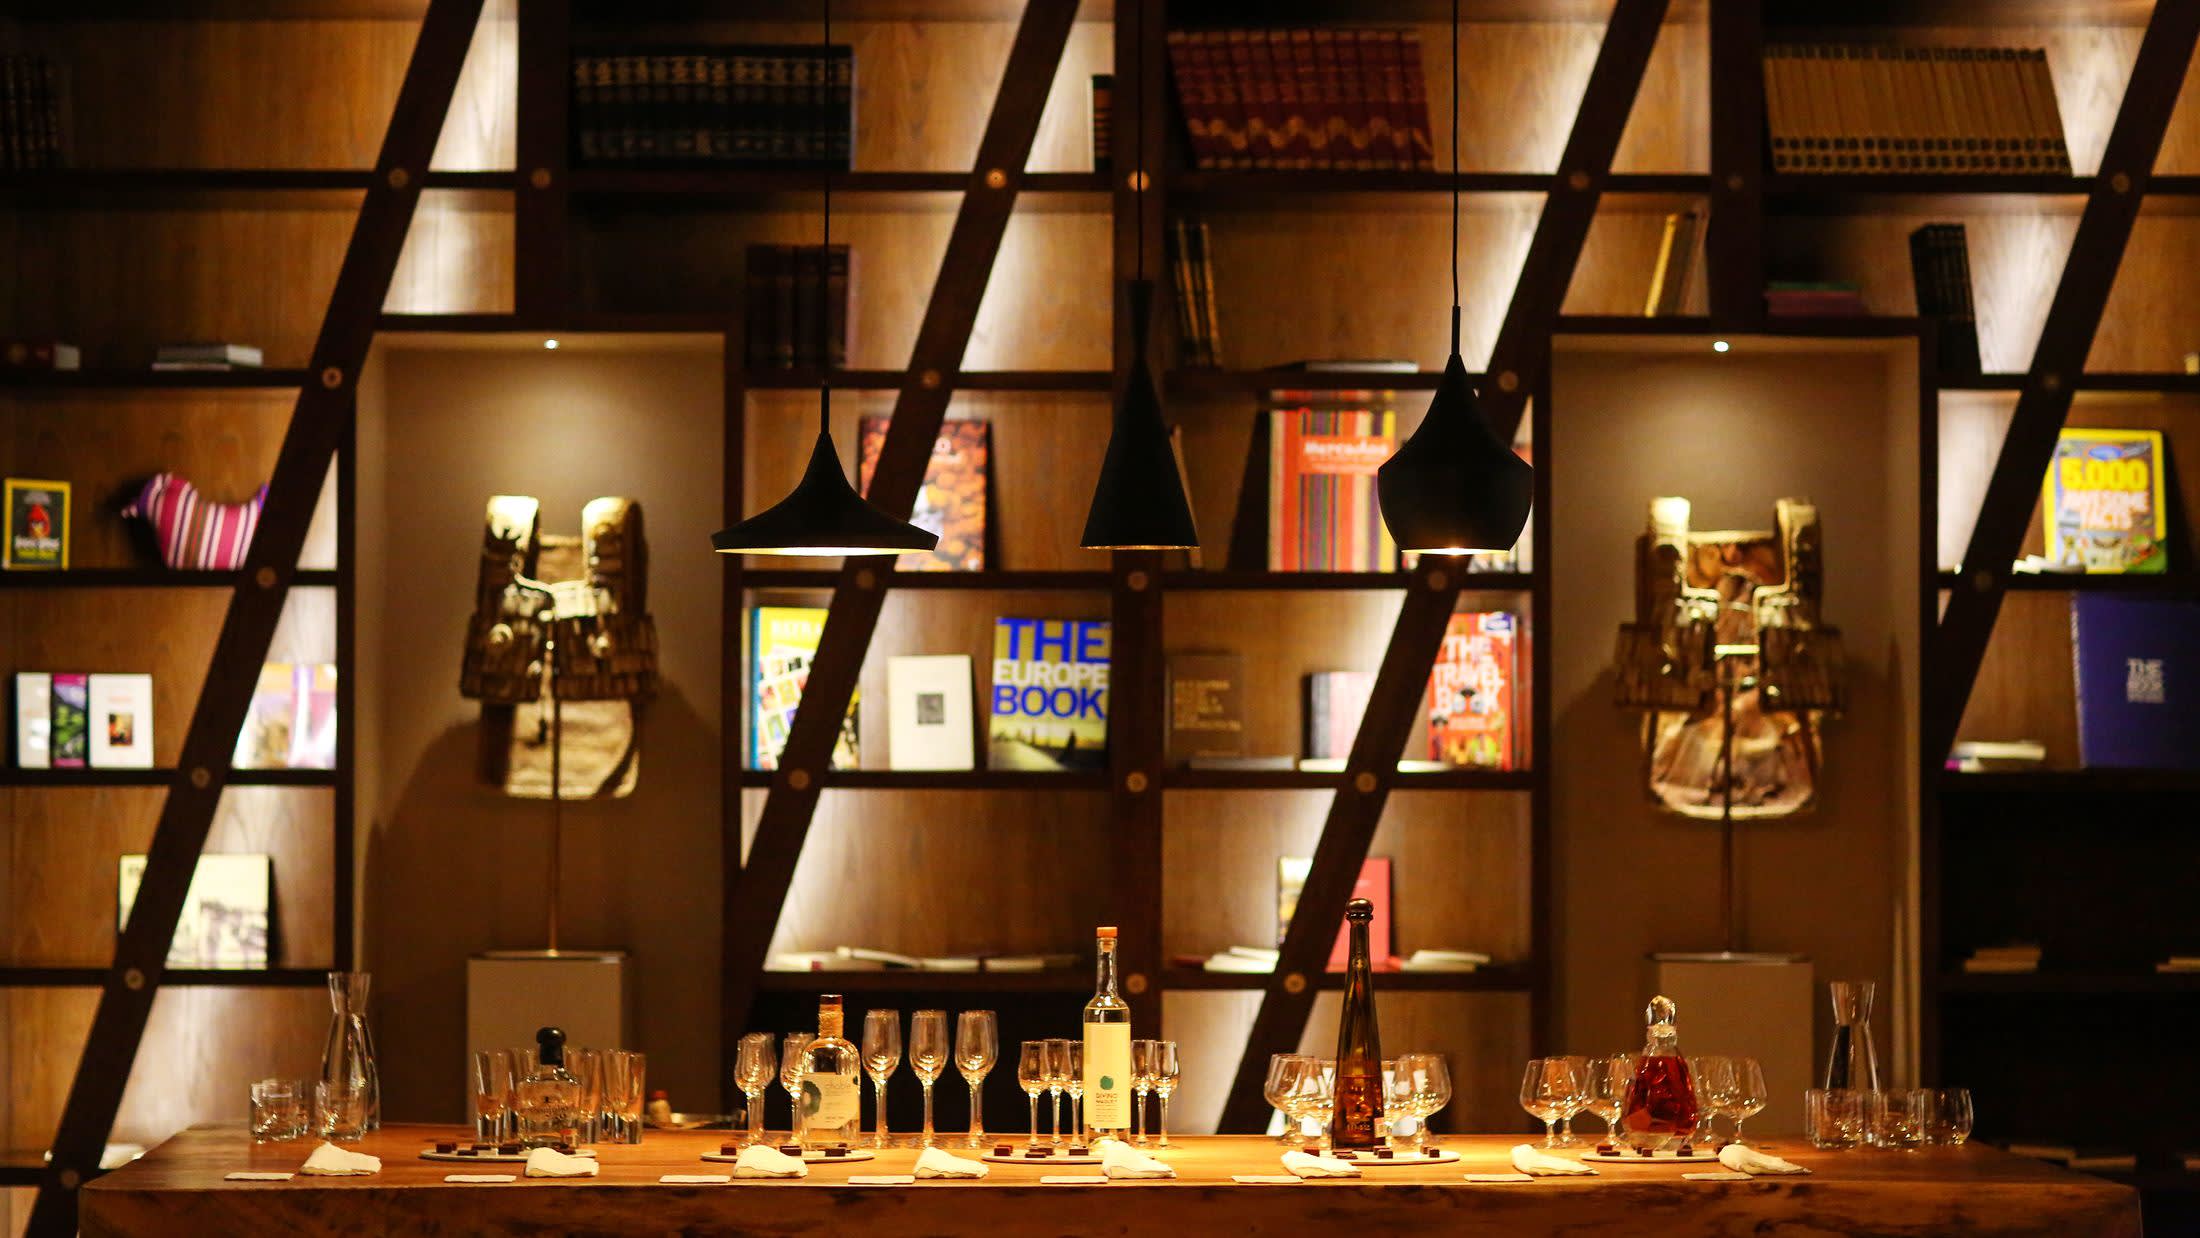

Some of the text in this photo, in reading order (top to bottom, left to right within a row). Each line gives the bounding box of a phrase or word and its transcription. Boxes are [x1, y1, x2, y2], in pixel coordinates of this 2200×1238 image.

[997, 617, 1112, 664] THE
[1444, 635, 1491, 665] THE
[993, 659, 1111, 690] EUROPE
[1433, 661, 1504, 690] TRAVEL
[992, 684, 1106, 719] BOOK
